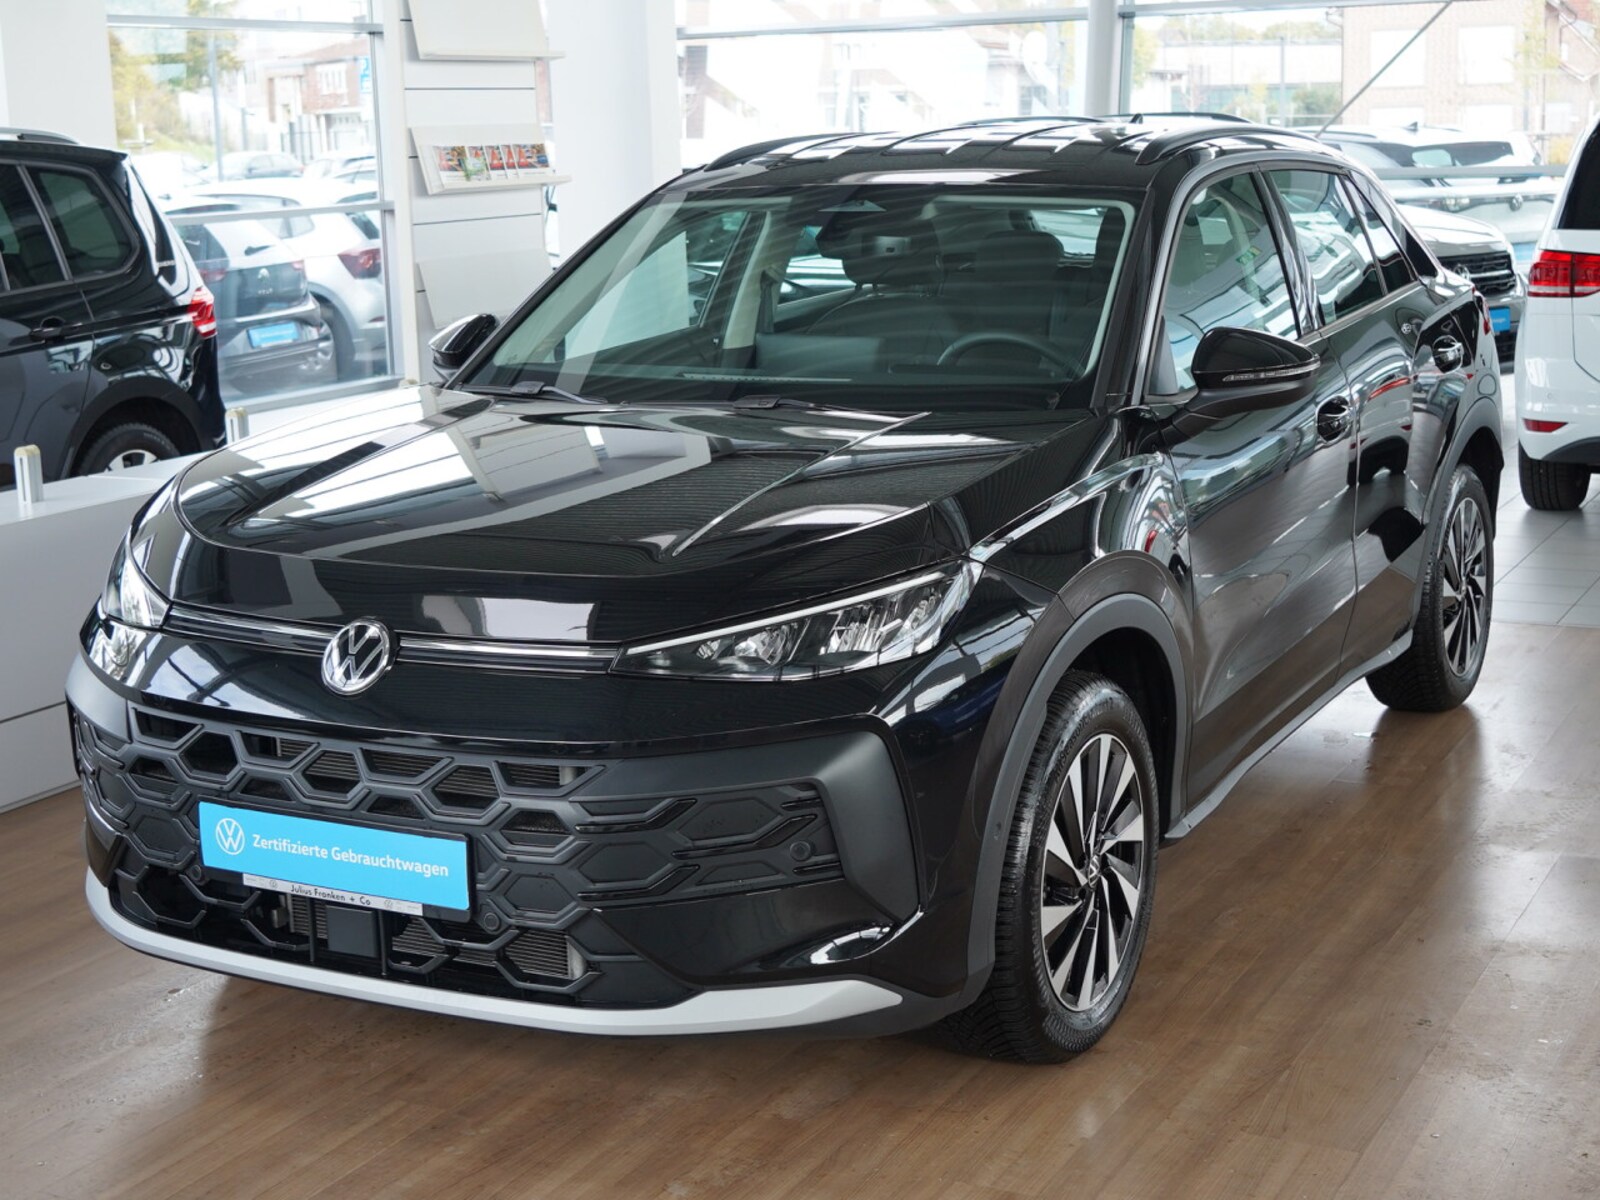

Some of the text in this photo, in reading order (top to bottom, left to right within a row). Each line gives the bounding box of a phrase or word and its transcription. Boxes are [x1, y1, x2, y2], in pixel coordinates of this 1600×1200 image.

[323, 620, 389, 692] VW
[216, 818, 245, 855] VW
[252, 834, 449, 878] Zertifizierte Gebrauchtwagen
[291, 884, 313, 896] Julius
[314, 888, 346, 902] Franken
[359, 896, 371, 906] Co
